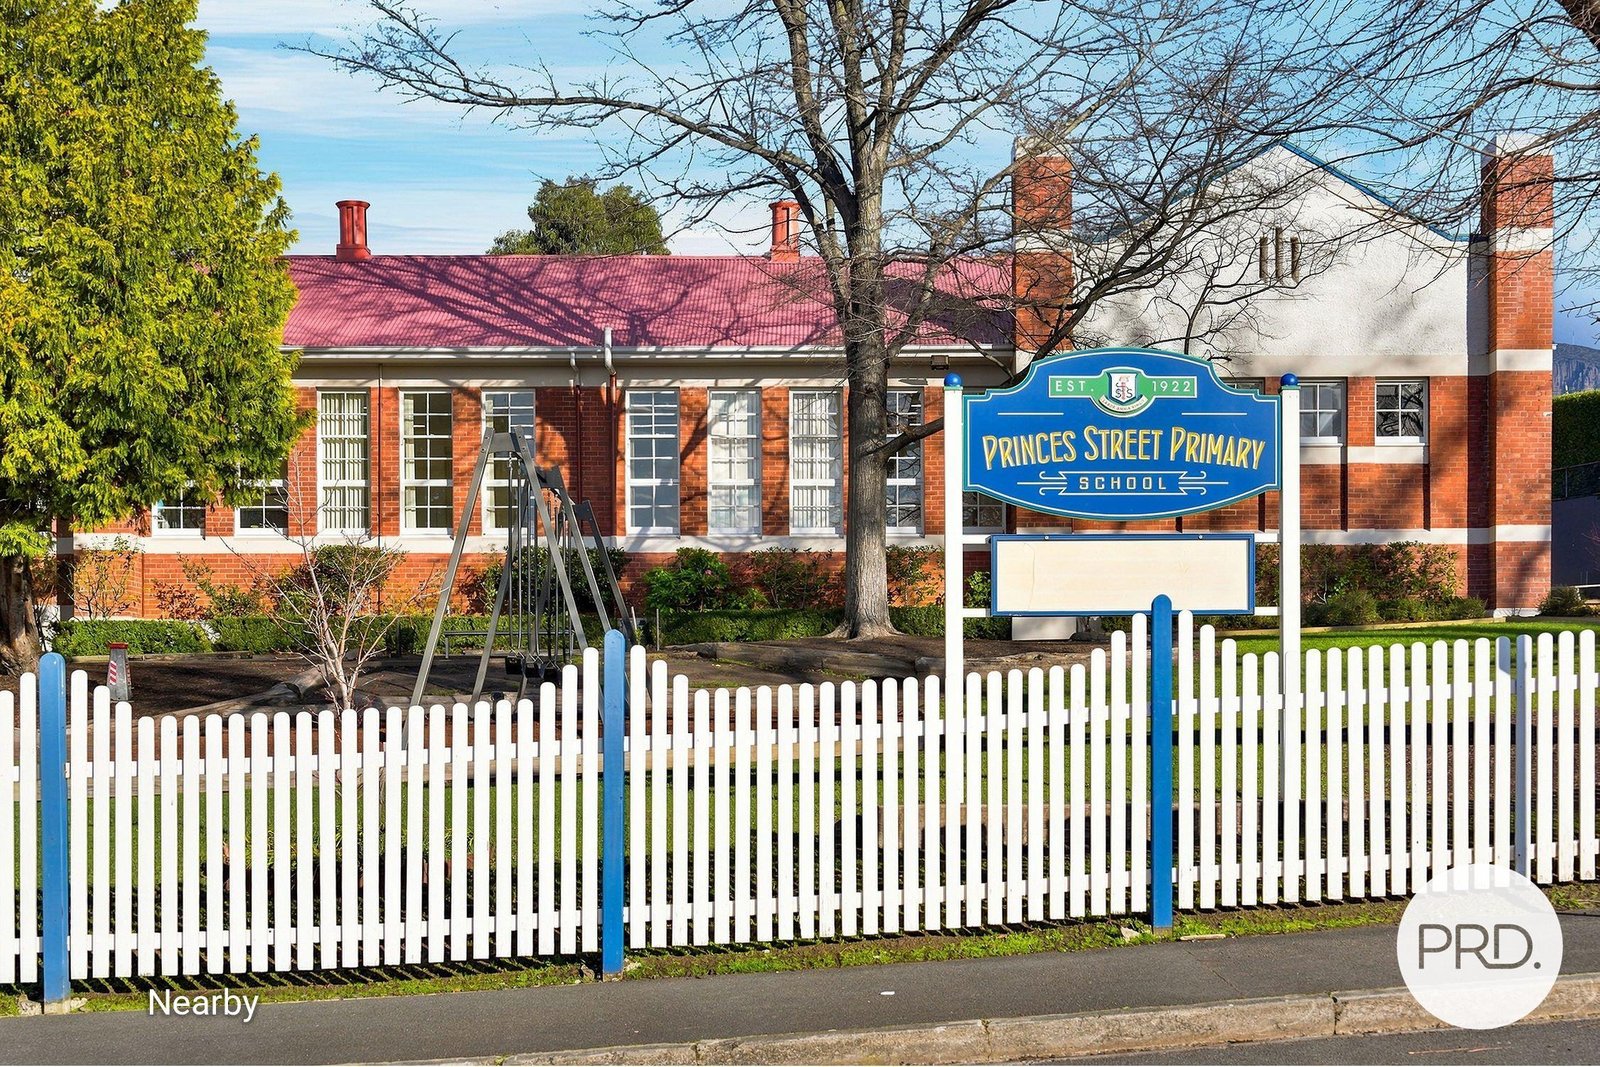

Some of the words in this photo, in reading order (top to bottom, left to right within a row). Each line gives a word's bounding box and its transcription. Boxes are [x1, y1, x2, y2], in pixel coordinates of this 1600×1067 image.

[1056, 379, 1095, 392] EST.
[1152, 379, 1192, 392] 1922
[982, 430, 1077, 470] PRINCES
[1084, 425, 1163, 461] STREET
[1171, 426, 1266, 470] PRIMARY
[1079, 476, 1168, 490] SCHOOL
